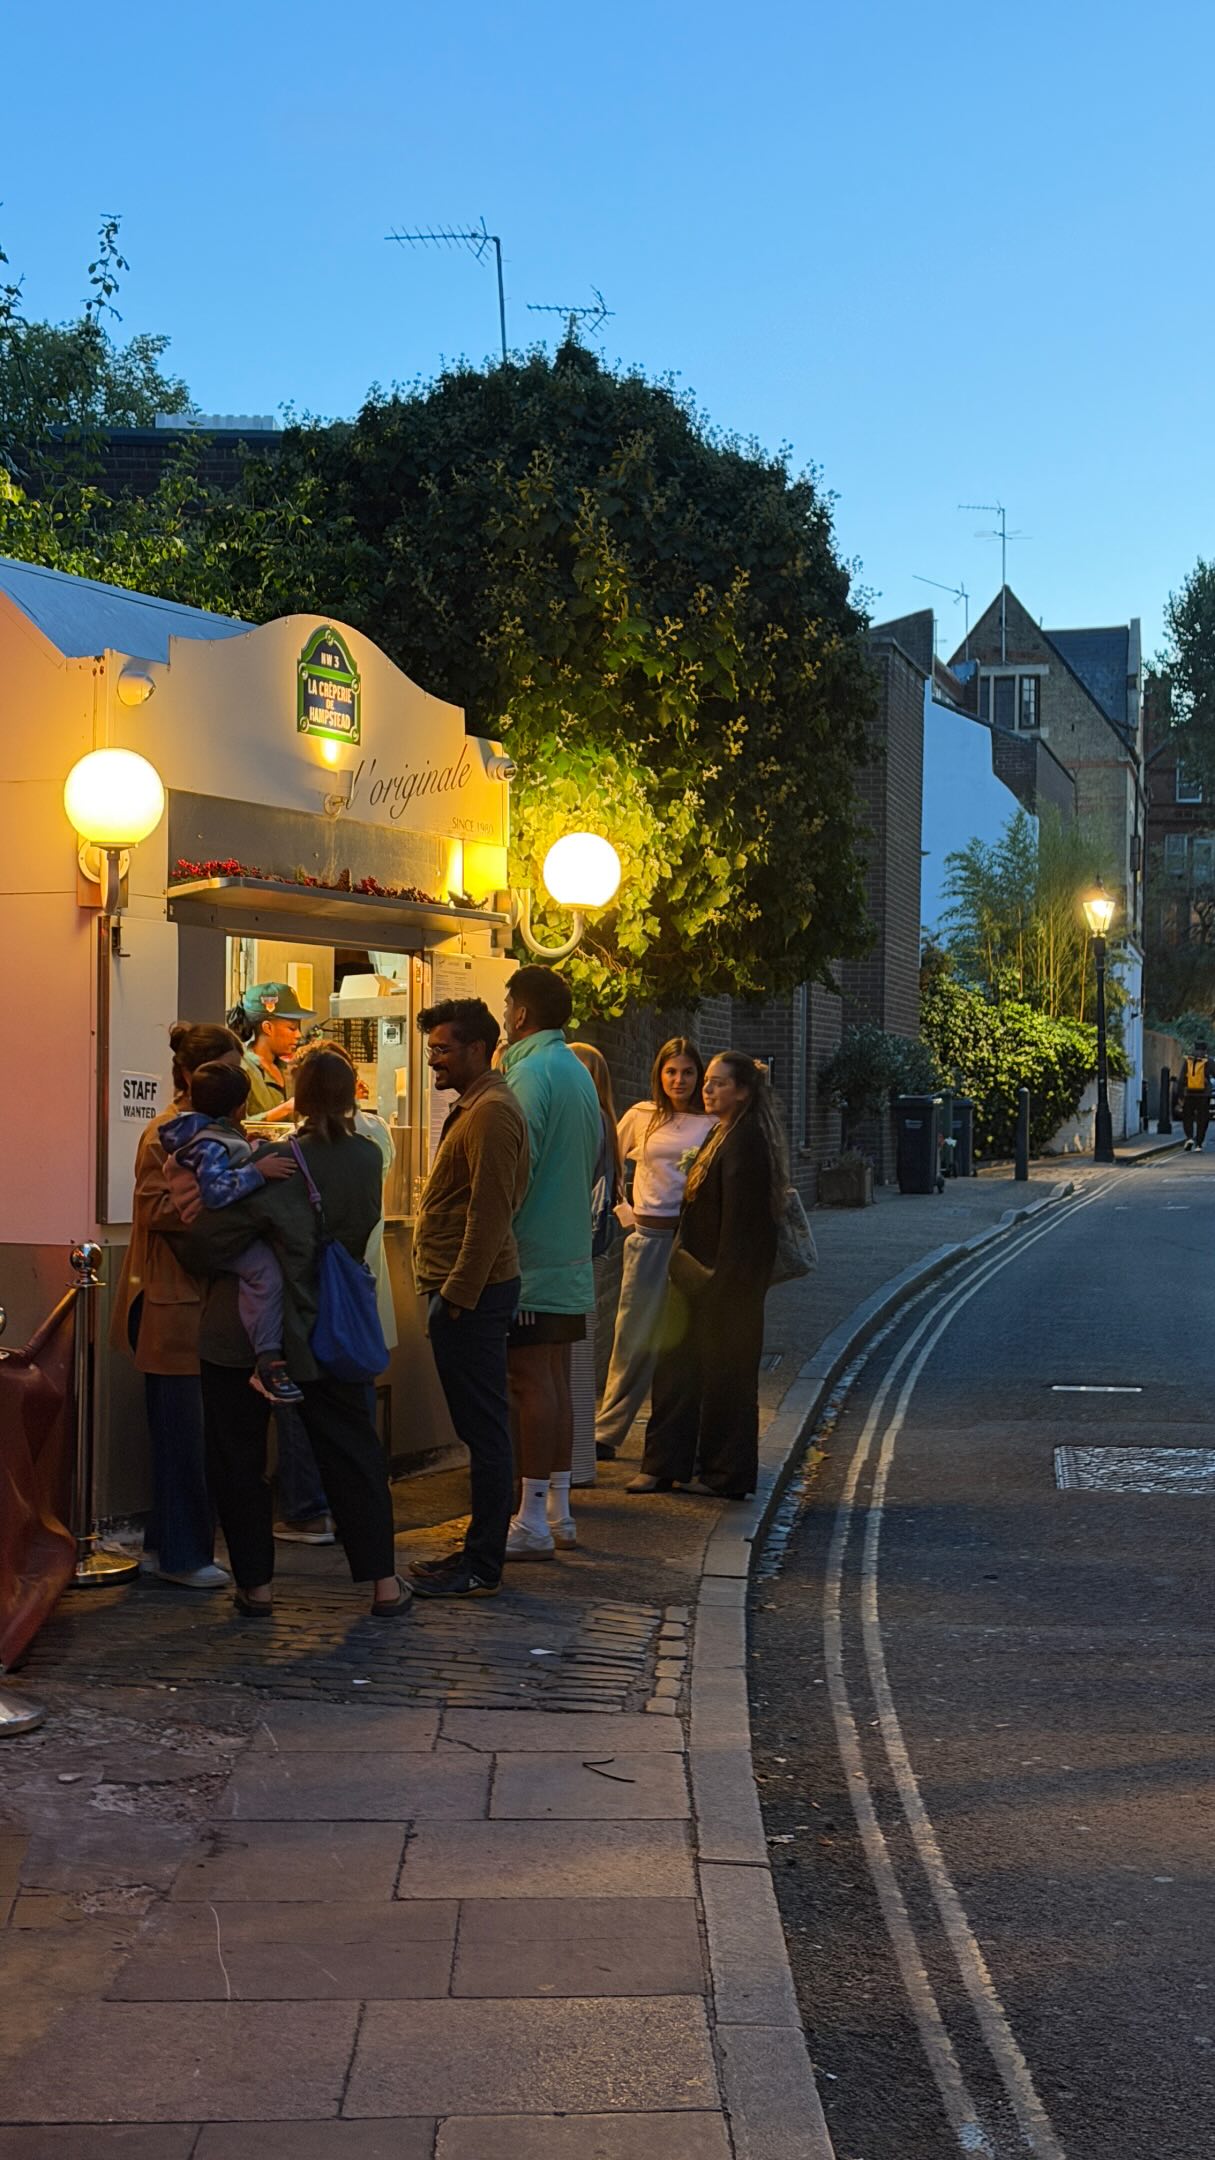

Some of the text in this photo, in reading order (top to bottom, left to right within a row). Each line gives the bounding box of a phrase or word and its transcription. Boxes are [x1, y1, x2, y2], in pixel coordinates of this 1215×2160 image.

[321, 652, 340, 668] NW 3
[308, 678, 318, 696] LA
[326, 699, 335, 710] DE
[309, 706, 351, 730] HAMPSTEAD
[452, 816, 474, 832] SINCE
[123, 1079, 157, 1101] STAFF
[123, 1105, 156, 1119] WANTED
